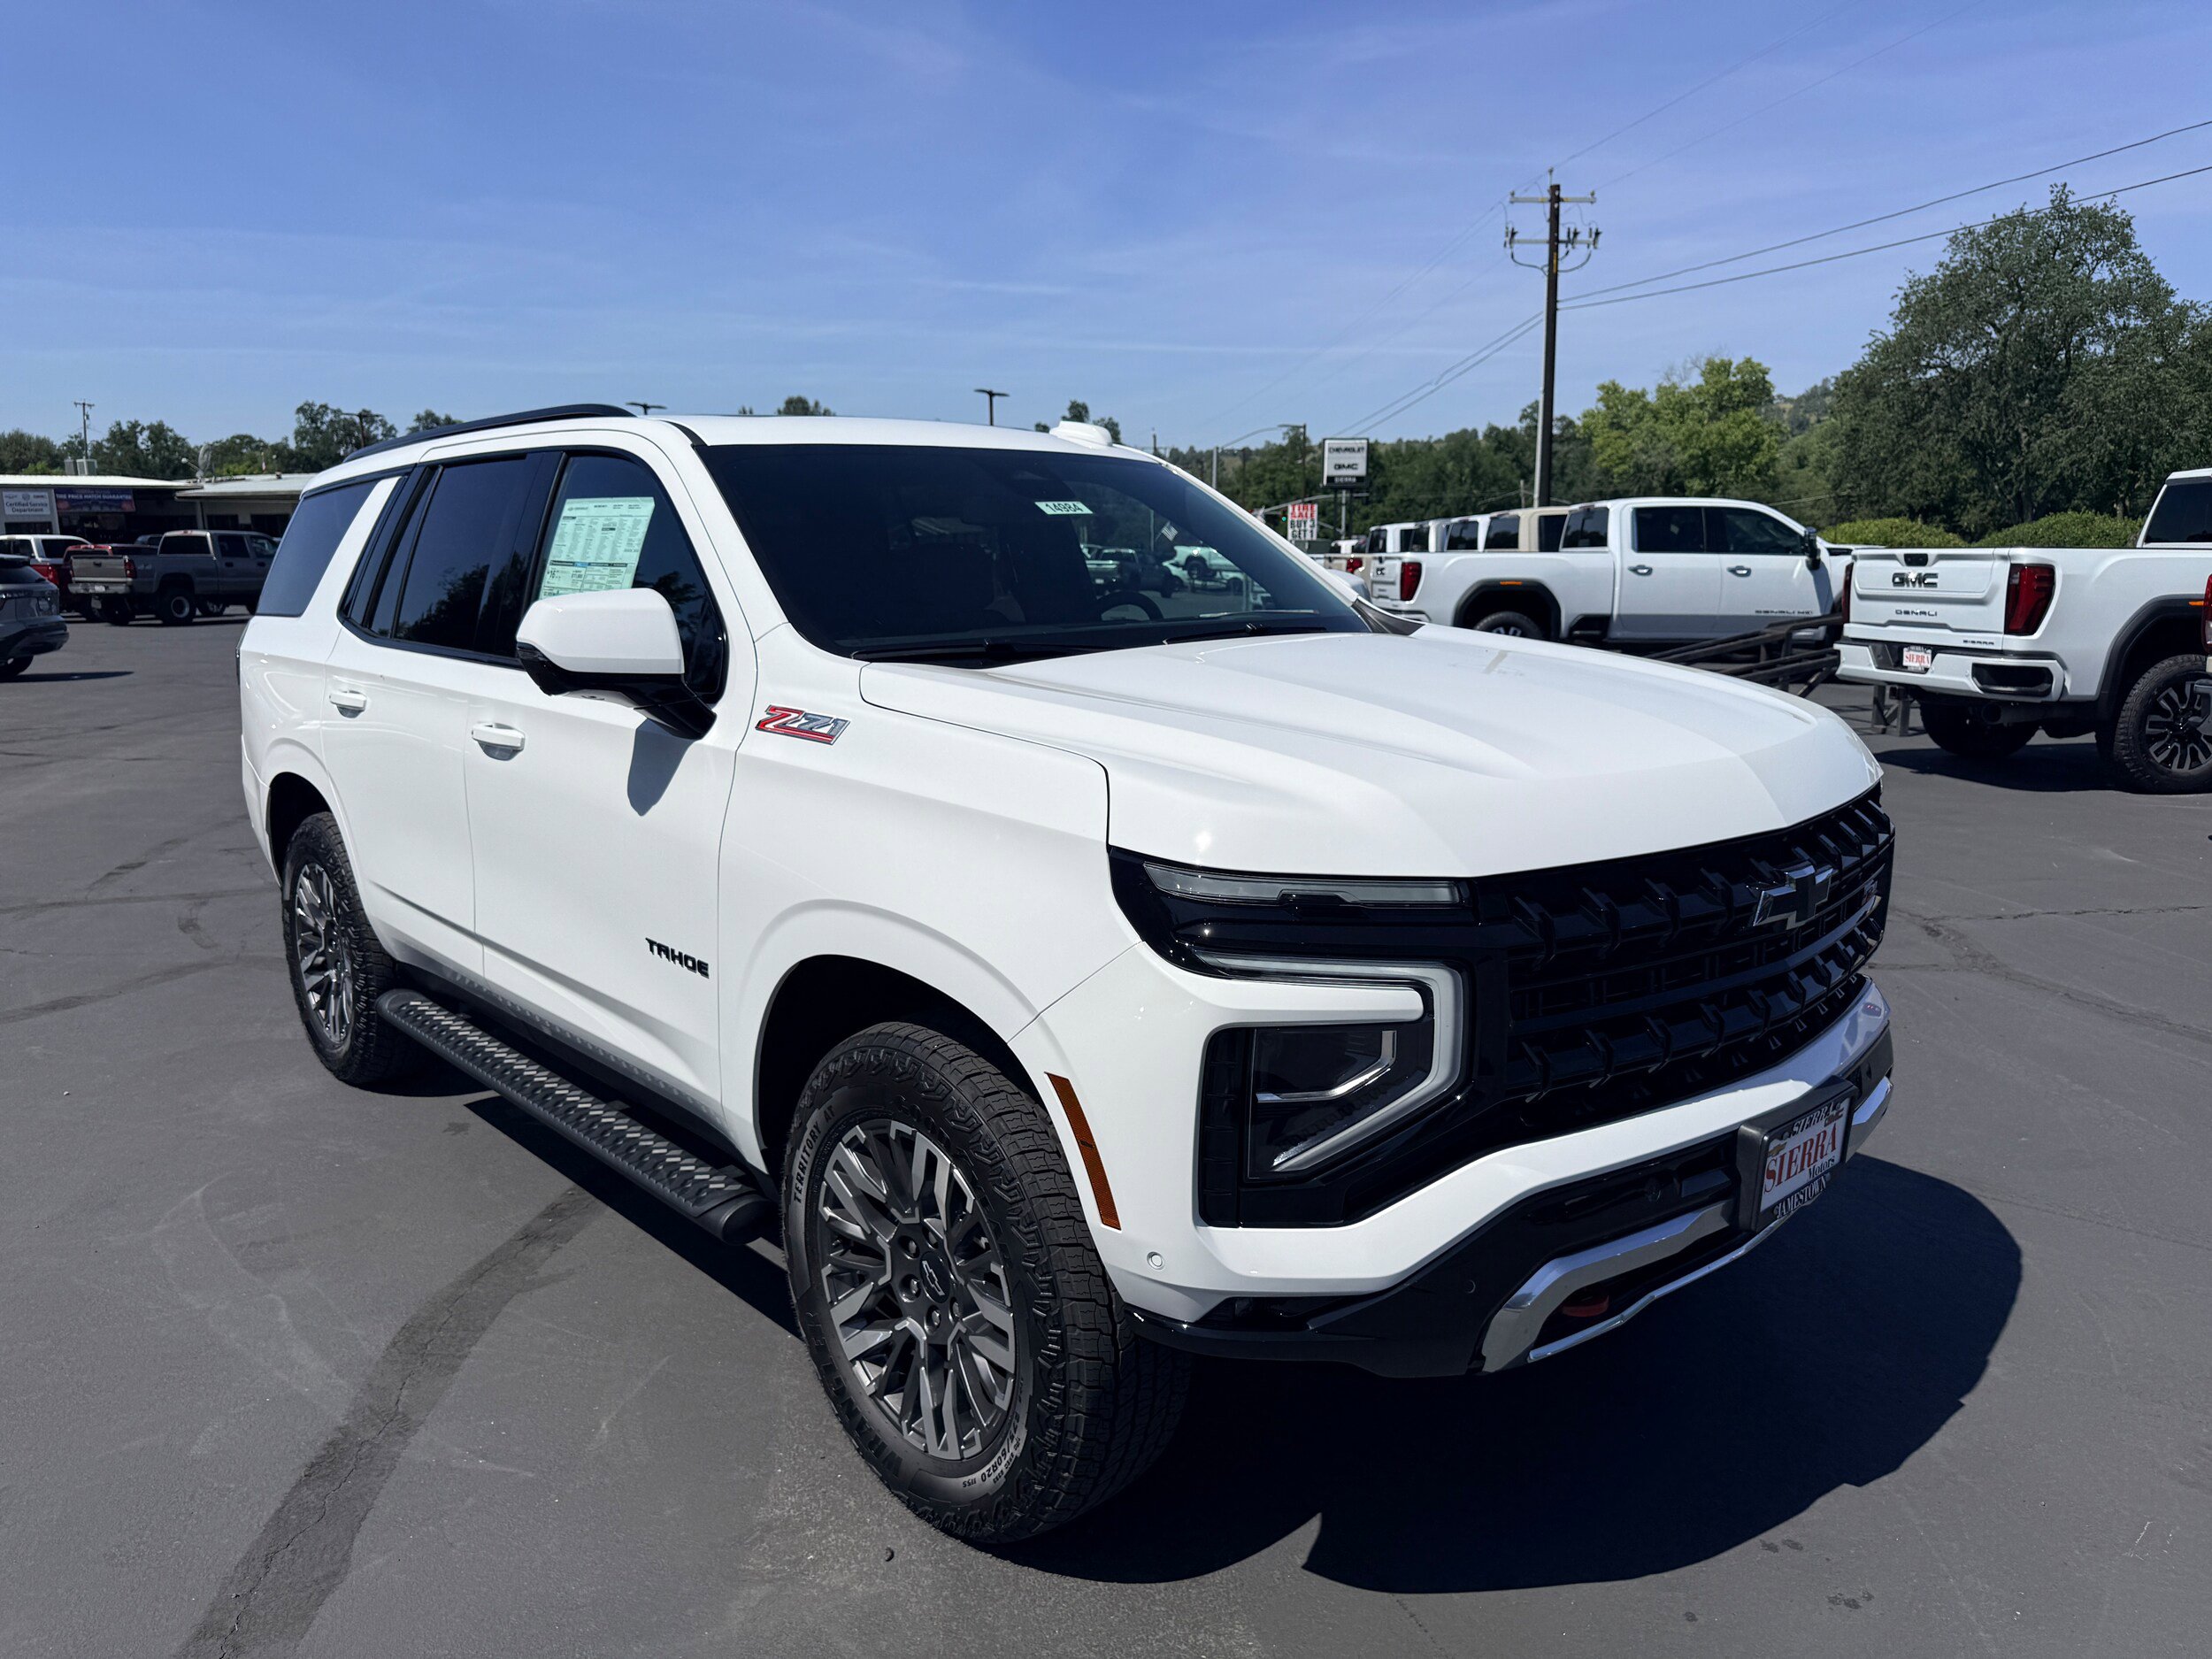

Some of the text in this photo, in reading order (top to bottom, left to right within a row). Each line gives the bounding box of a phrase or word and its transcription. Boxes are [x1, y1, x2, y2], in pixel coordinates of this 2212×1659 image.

[1045, 503, 1084, 512] 14984
[1291, 519, 1307, 528] BUY
[1892, 572, 1939, 588] GMC
[1905, 655, 1930, 664] SIERRA
[755, 704, 851, 746] Z71
[645, 937, 710, 979] TAHOE
[1792, 1102, 1835, 1136] SIERRA
[794, 1105, 835, 1203] TERRITORY AT
[1764, 1123, 1837, 1193] SIERRA
[1808, 1156, 1836, 1180] Motors
[1776, 1174, 1826, 1219] JAMESTOWN
